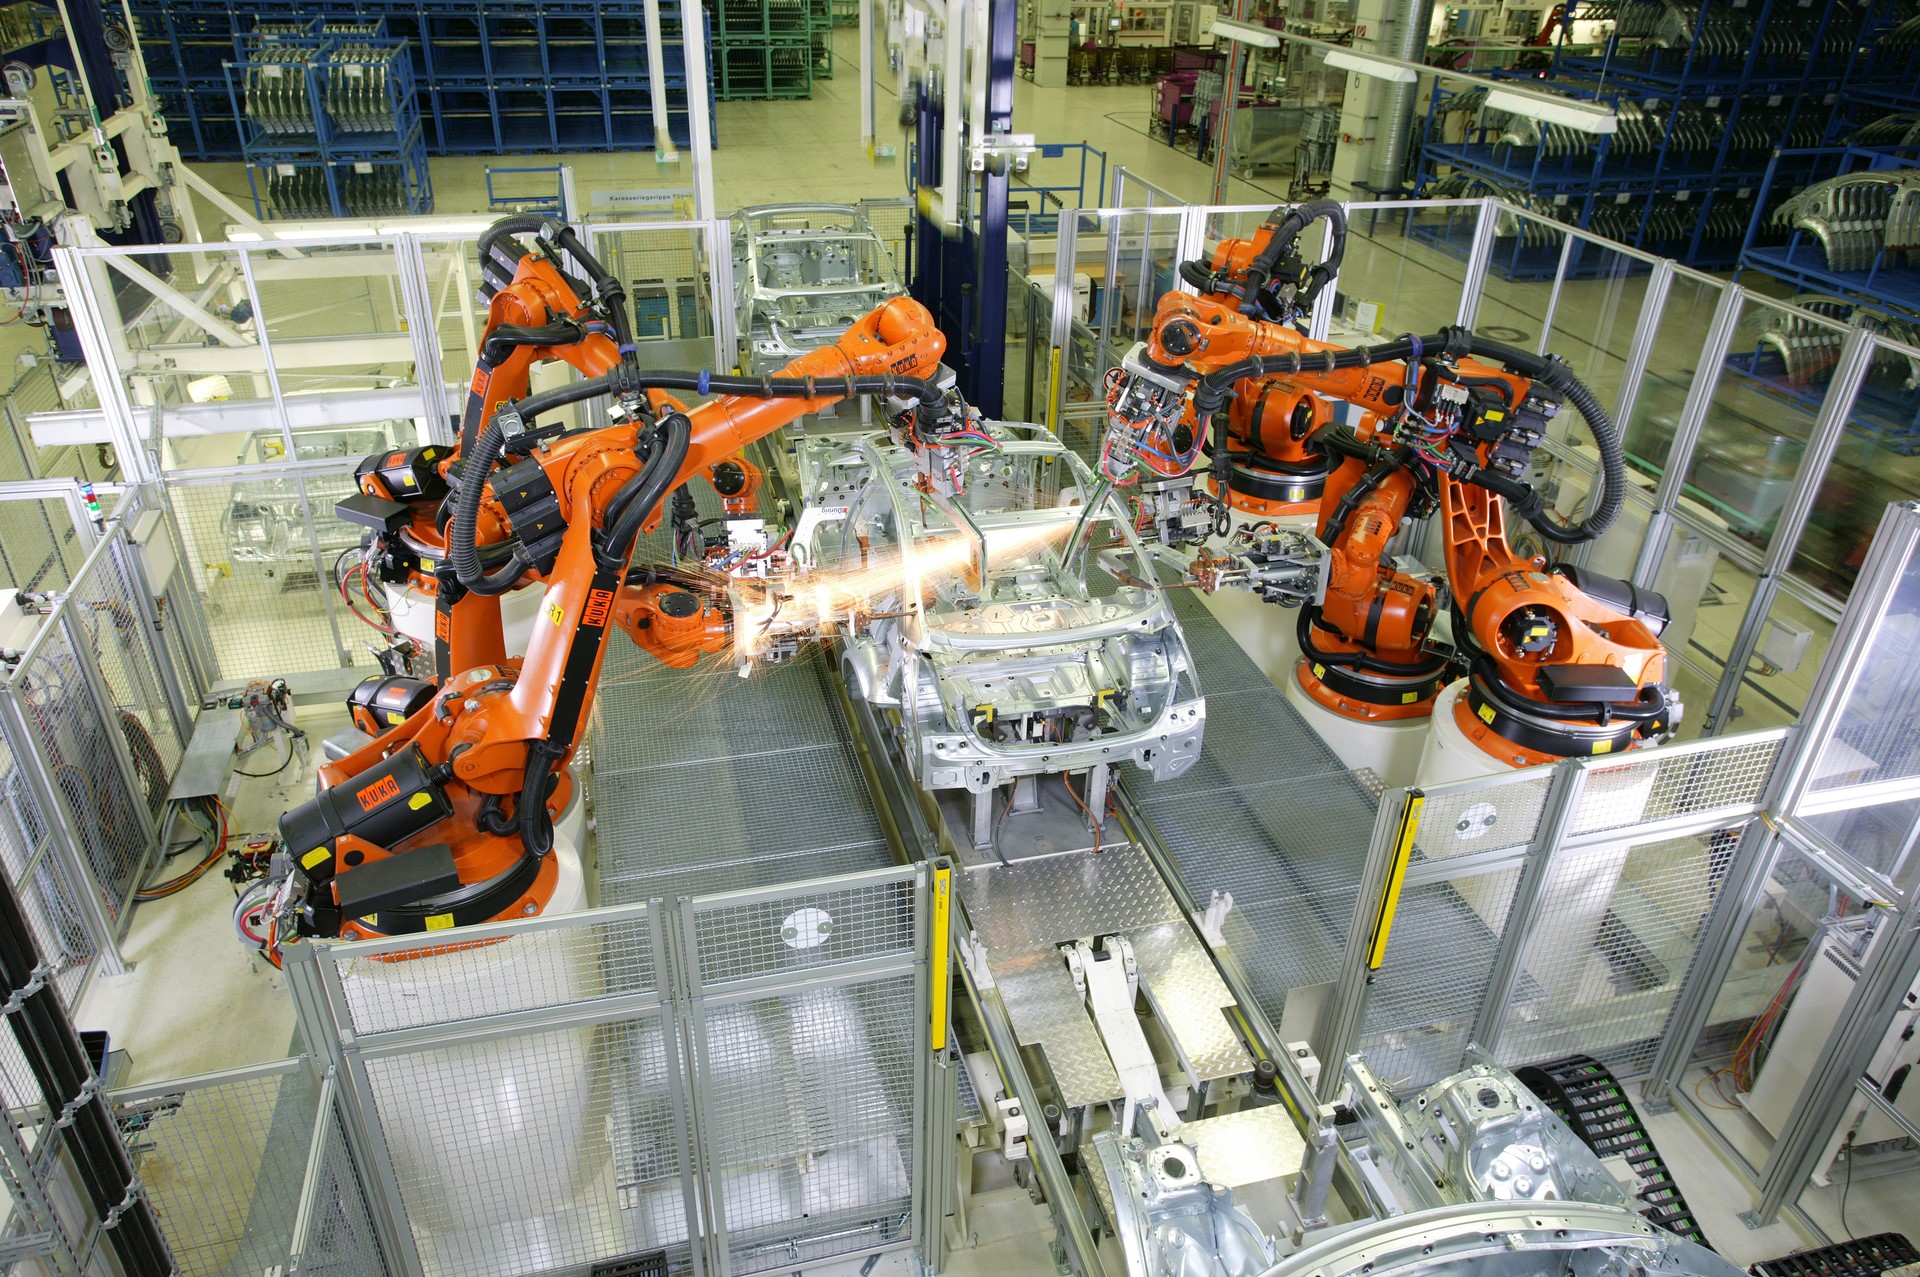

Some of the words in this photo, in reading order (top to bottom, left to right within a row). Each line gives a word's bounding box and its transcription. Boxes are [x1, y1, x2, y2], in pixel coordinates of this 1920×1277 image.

[609, 194, 671, 202] Karosseriegerippe
[890, 356, 918, 375] KUKA
[475, 370, 487, 396] KUKA
[1363, 376, 1385, 402] KUKA
[1391, 582, 1414, 596] KUKA
[587, 591, 610, 625] KUKA
[440, 613, 448, 639] KUKA
[360, 780, 398, 808] KUKA
[939, 878, 947, 895] SICK
